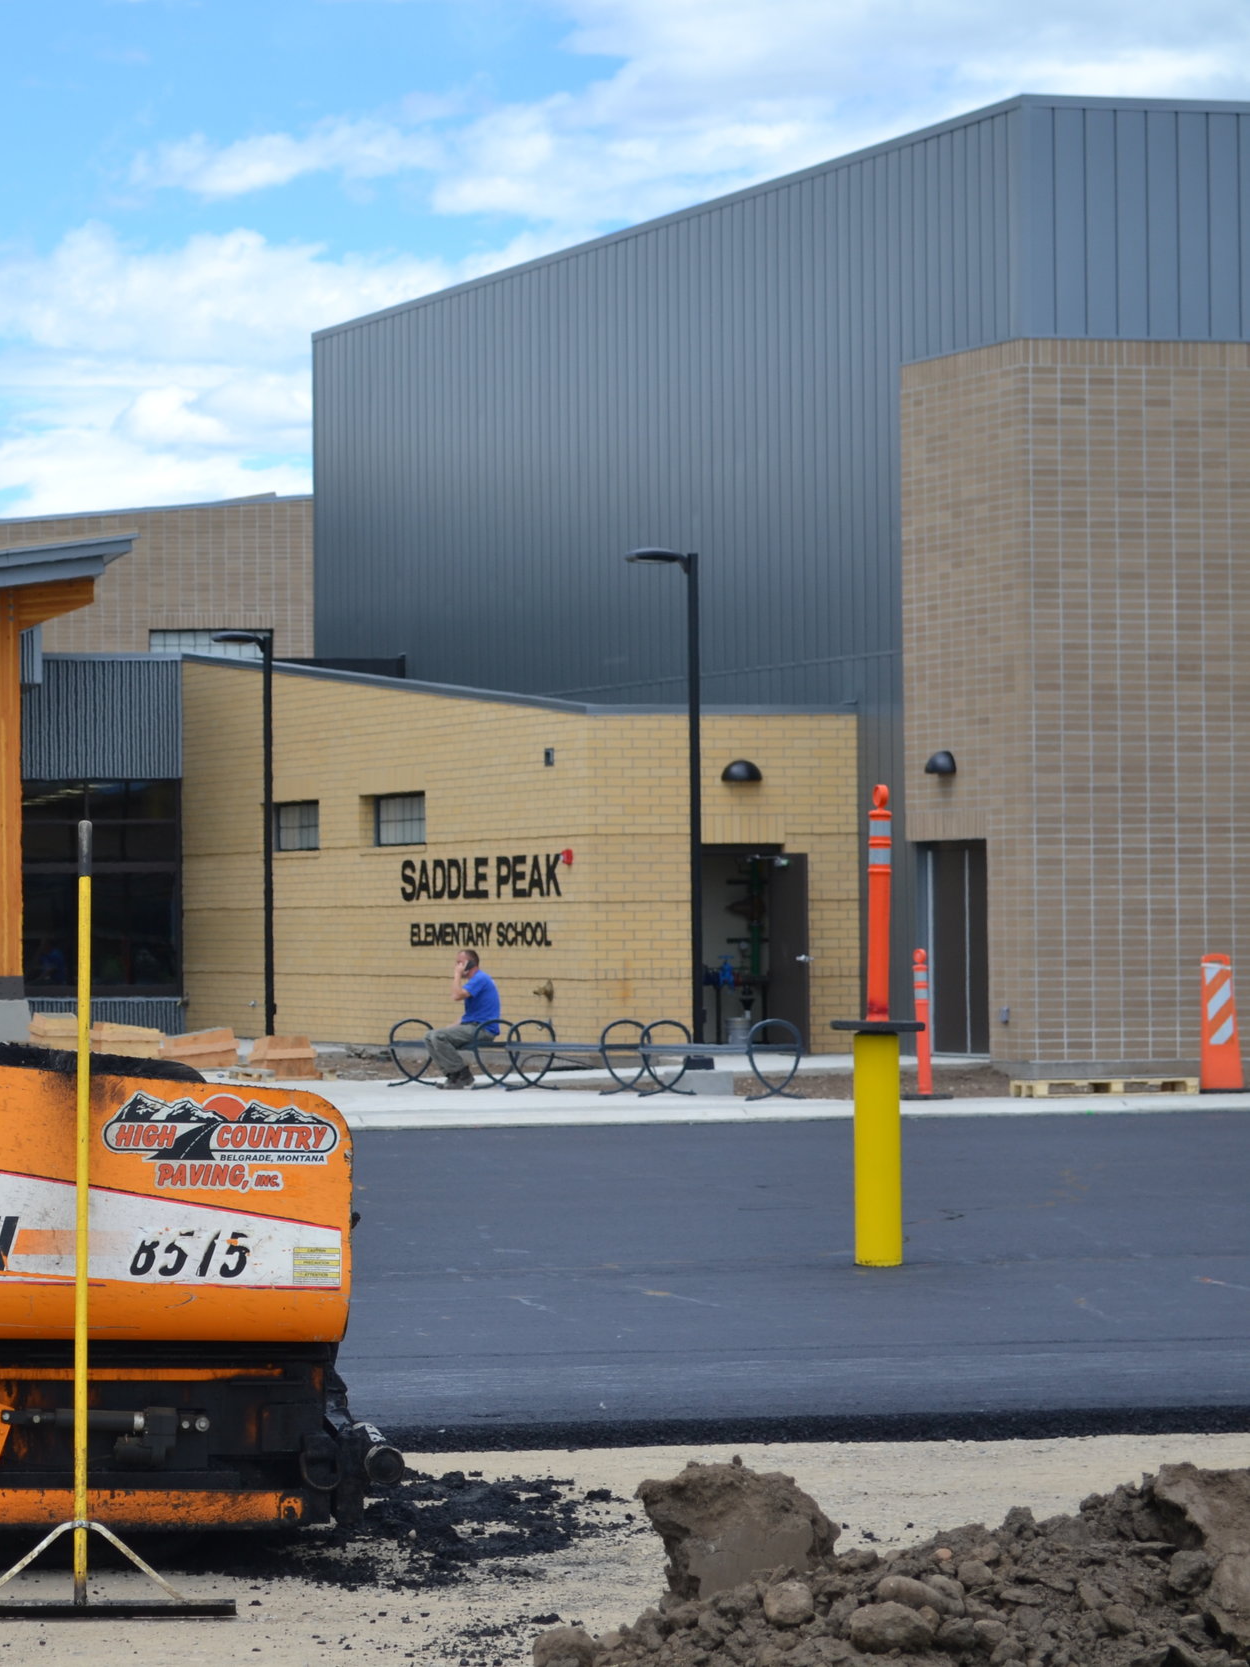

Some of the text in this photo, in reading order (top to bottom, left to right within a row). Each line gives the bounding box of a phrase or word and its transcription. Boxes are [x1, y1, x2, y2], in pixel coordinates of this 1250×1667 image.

[401, 853, 562, 901] SADDLE PEAK
[410, 921, 552, 947] ELEMENTARY SCHOOL
[115, 1124, 328, 1151] HIGH COUNTRY
[220, 1154, 325, 1162] BELGRADE, MONTANA
[157, 1163, 280, 1190] PAVING, INC.
